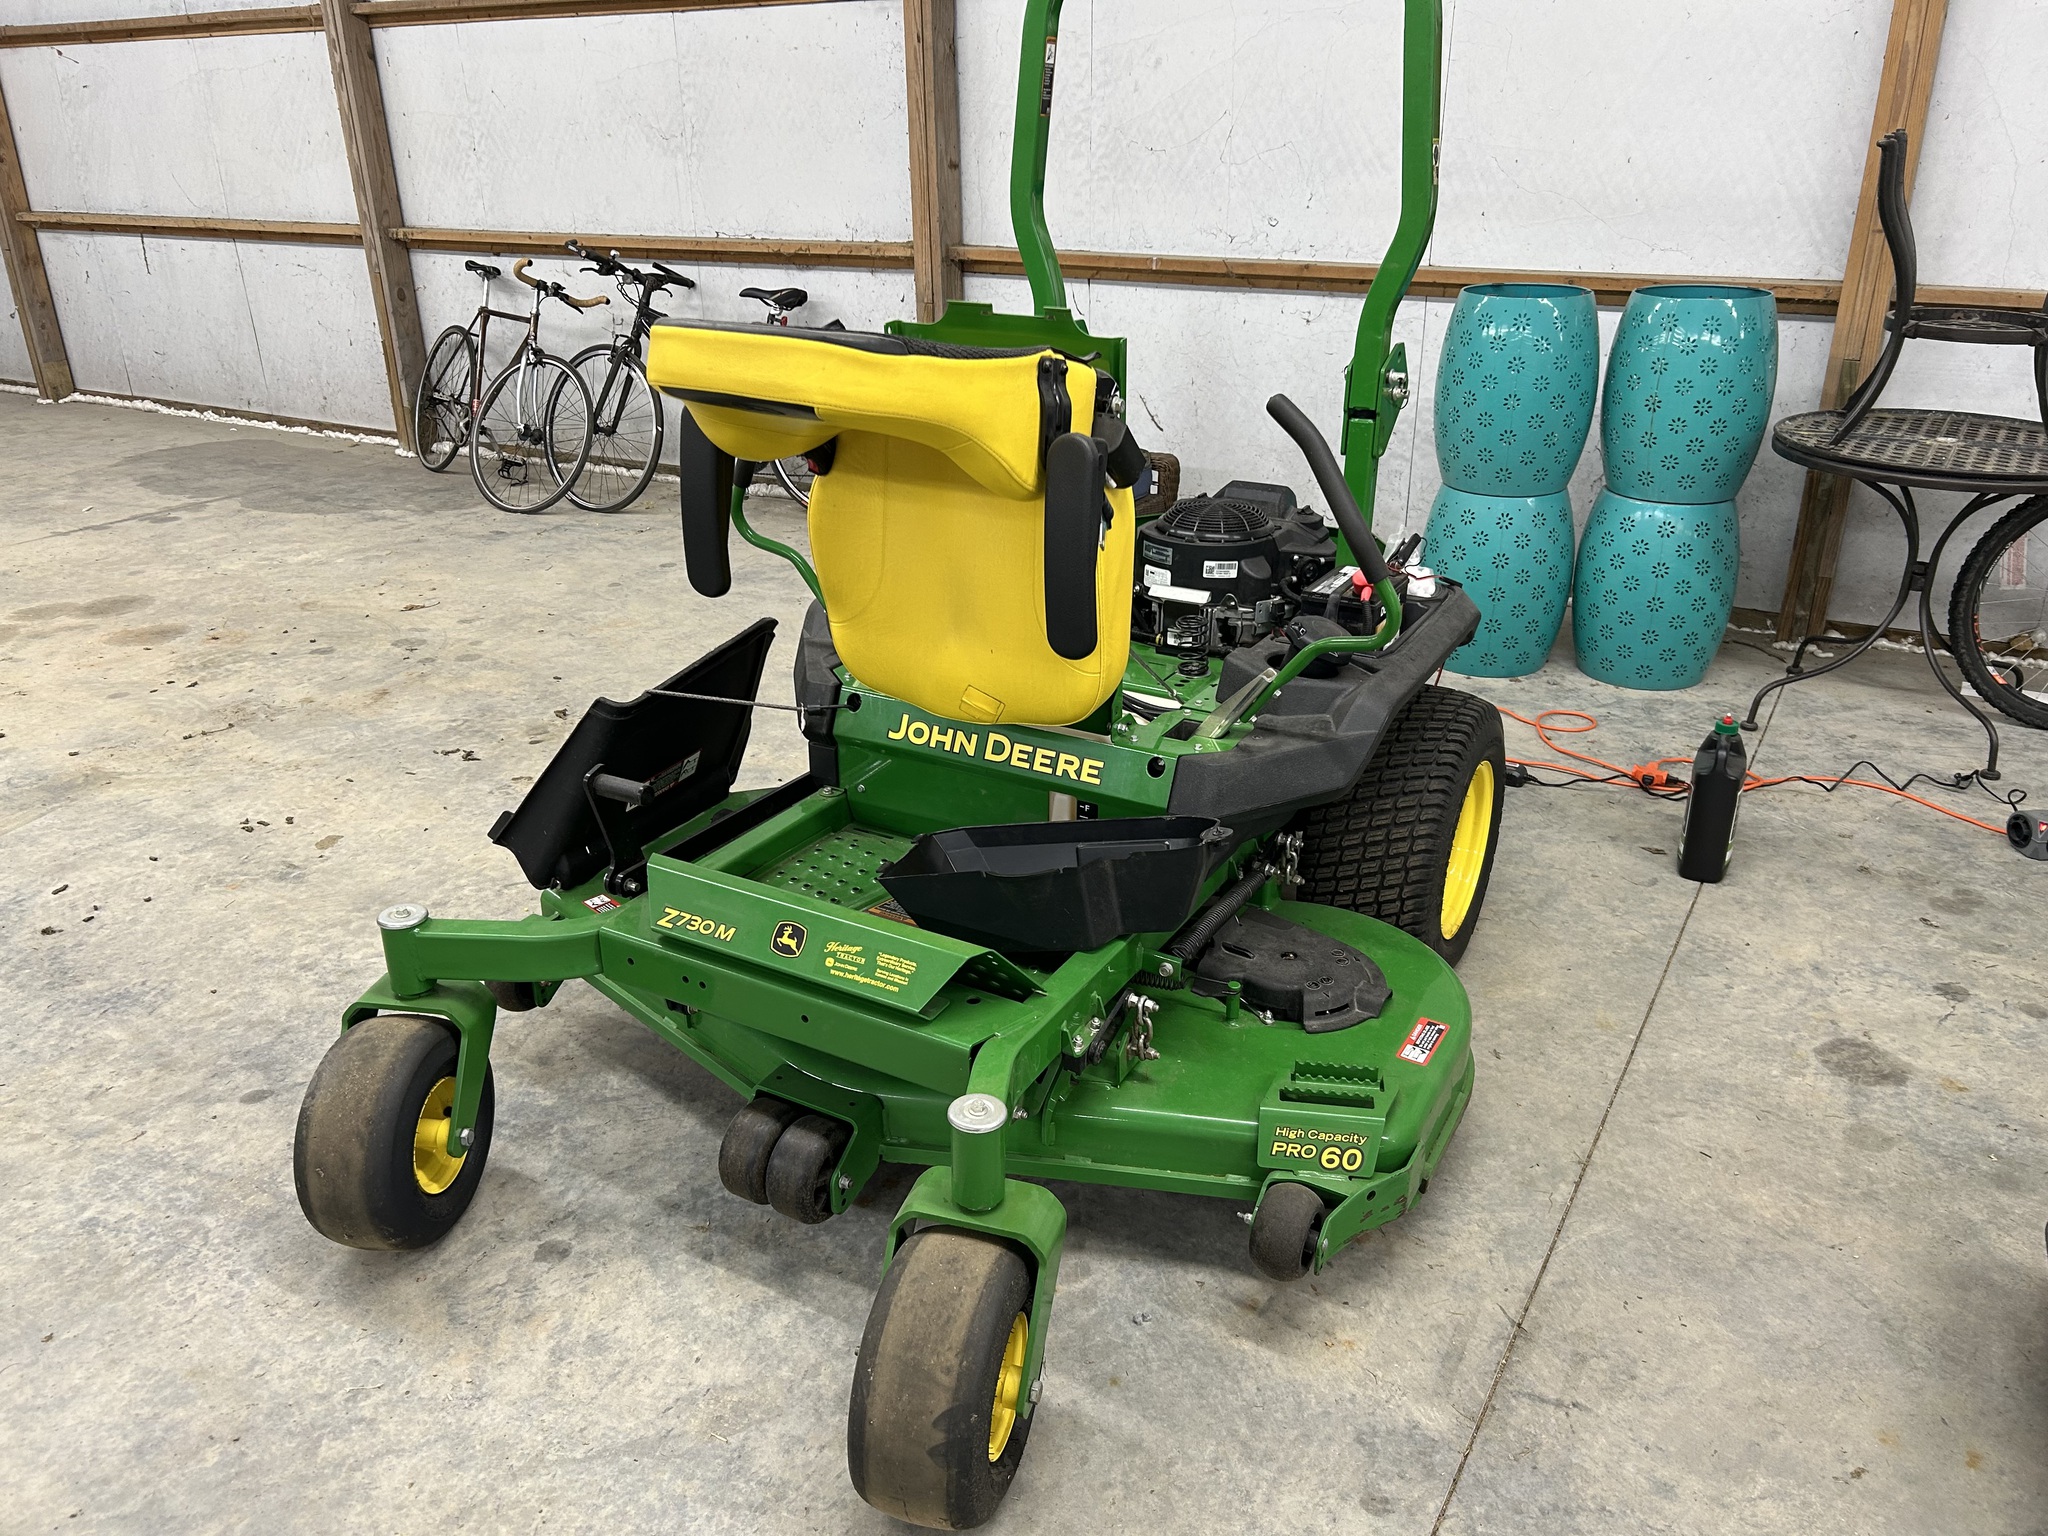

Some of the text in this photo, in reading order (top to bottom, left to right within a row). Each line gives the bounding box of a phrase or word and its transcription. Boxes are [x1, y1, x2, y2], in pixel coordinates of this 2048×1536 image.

[887, 713, 1105, 785] JOHN DEERE
[823, 941, 863, 954] Heritage
[830, 969, 899, 993] www.heritagetractor.com
[1275, 1126, 1368, 1146] High Capacity
[1271, 1141, 1364, 1171] PRO 60
